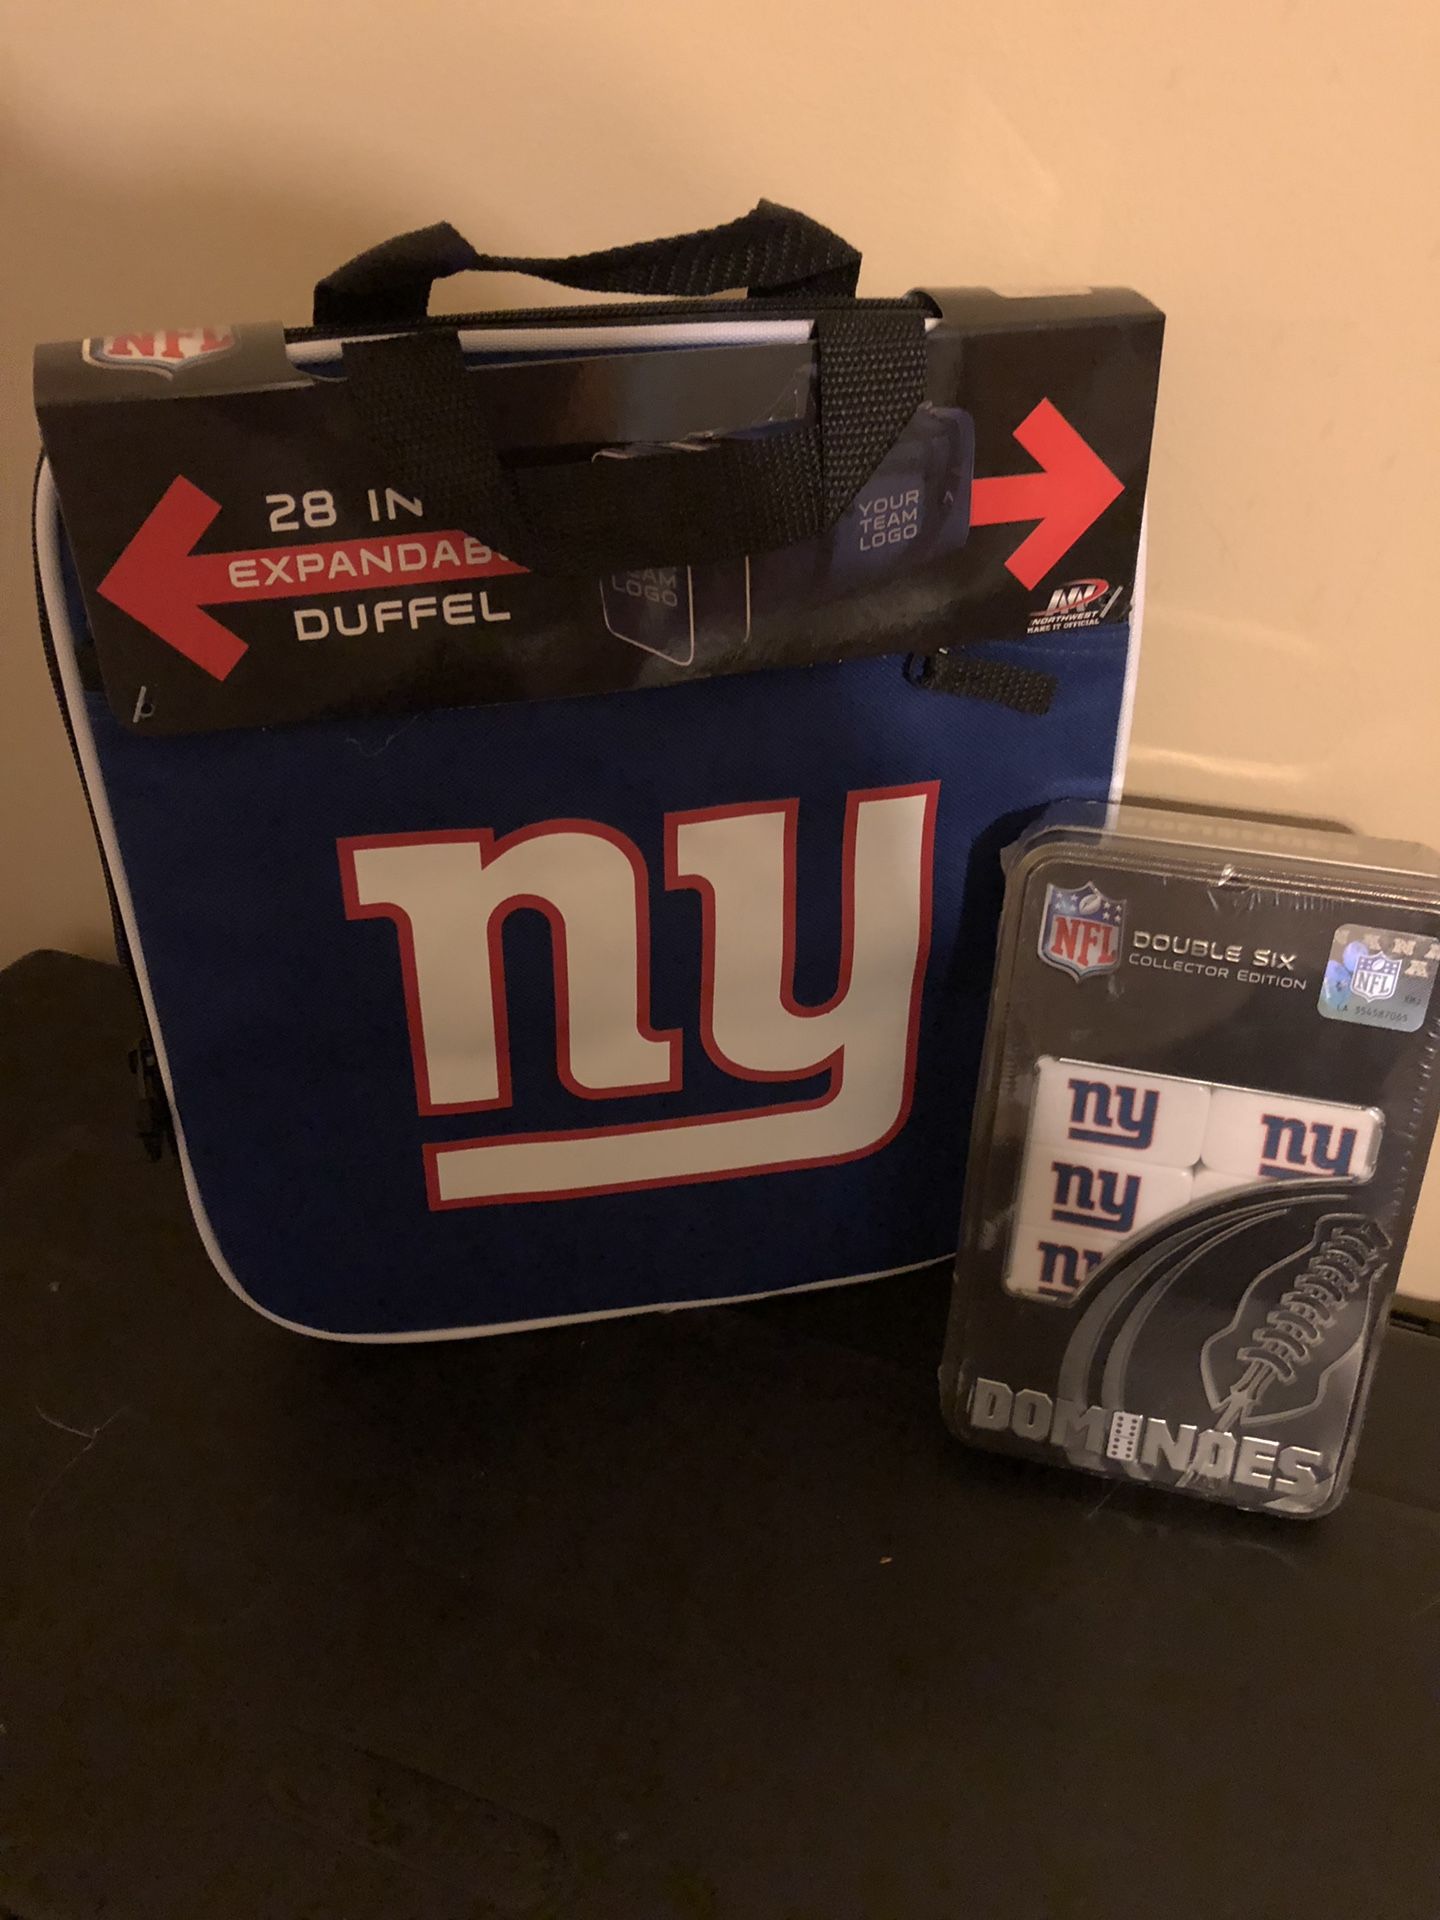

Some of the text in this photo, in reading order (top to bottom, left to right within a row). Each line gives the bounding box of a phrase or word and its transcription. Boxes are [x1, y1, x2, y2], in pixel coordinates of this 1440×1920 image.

[265, 487, 423, 532] 28 IN
[859, 490, 919, 517] YOUR
[859, 507, 918, 533] TEAM
[860, 524, 918, 551] LOGO
[228, 538, 509, 589] EXPANDAB
[611, 574, 678, 608] LOGO
[294, 591, 511, 641] DUFFEL
[1031, 610, 1099, 626] NORTHWEST
[1052, 622, 1062, 631] IT
[1051, 917, 1116, 967] NFL
[1132, 930, 1299, 971] DOUBLE SIX
[1128, 953, 1308, 991] COLLECTOR EDITION
[1356, 971, 1390, 995] NFL
[336, 780, 941, 1211] ny
[1068, 1078, 1160, 1150] ny
[1051, 1161, 1142, 1233] ny
[1037, 1240, 1103, 1298] n
[970, 1377, 1323, 1496] DOMINOES
